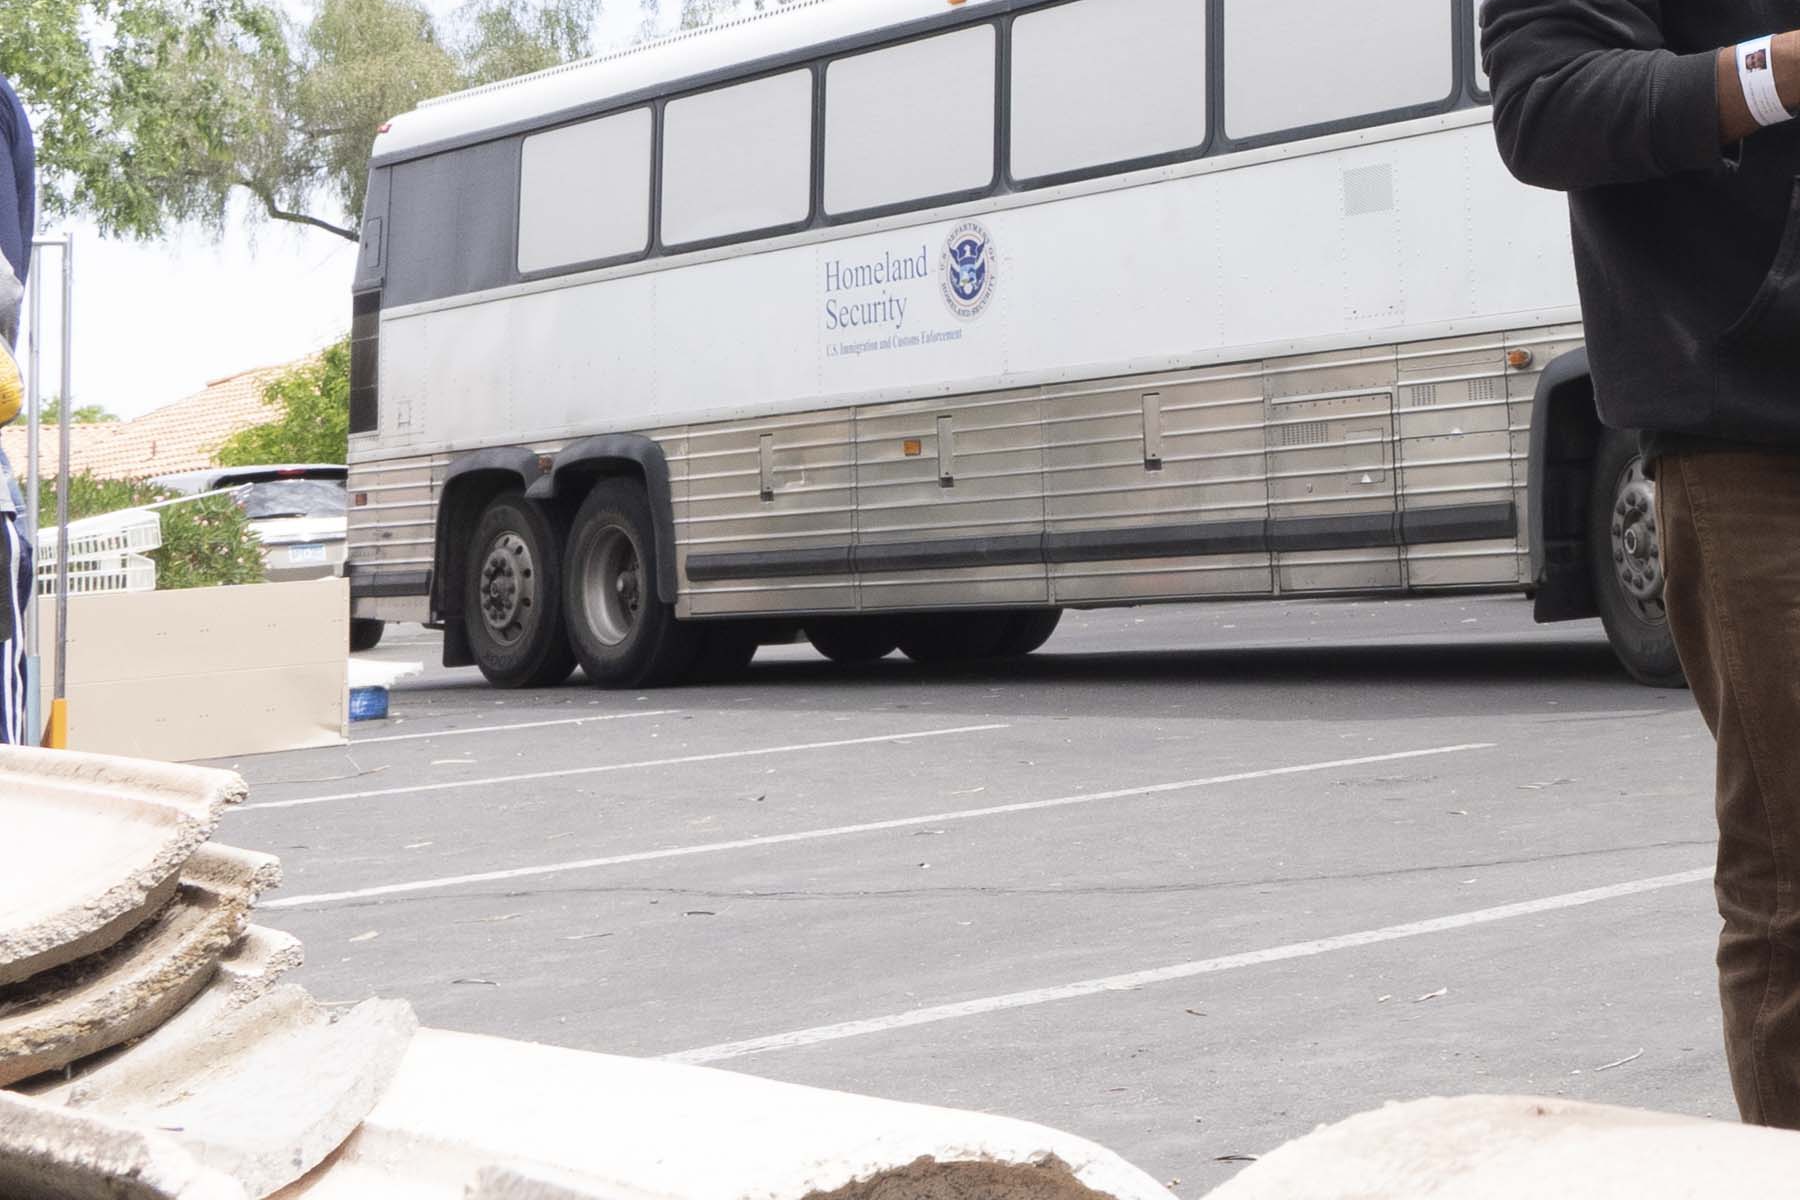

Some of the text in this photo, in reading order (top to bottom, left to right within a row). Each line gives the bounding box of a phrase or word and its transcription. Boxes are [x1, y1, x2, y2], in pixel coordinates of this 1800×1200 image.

[825, 244, 928, 292] Homeland
[826, 289, 907, 330] Security
[840, 340, 878, 357] Immigration
[880, 335, 891, 350] and
[893, 334, 920, 348] Customs
[920, 328, 962, 345] Enforcement
